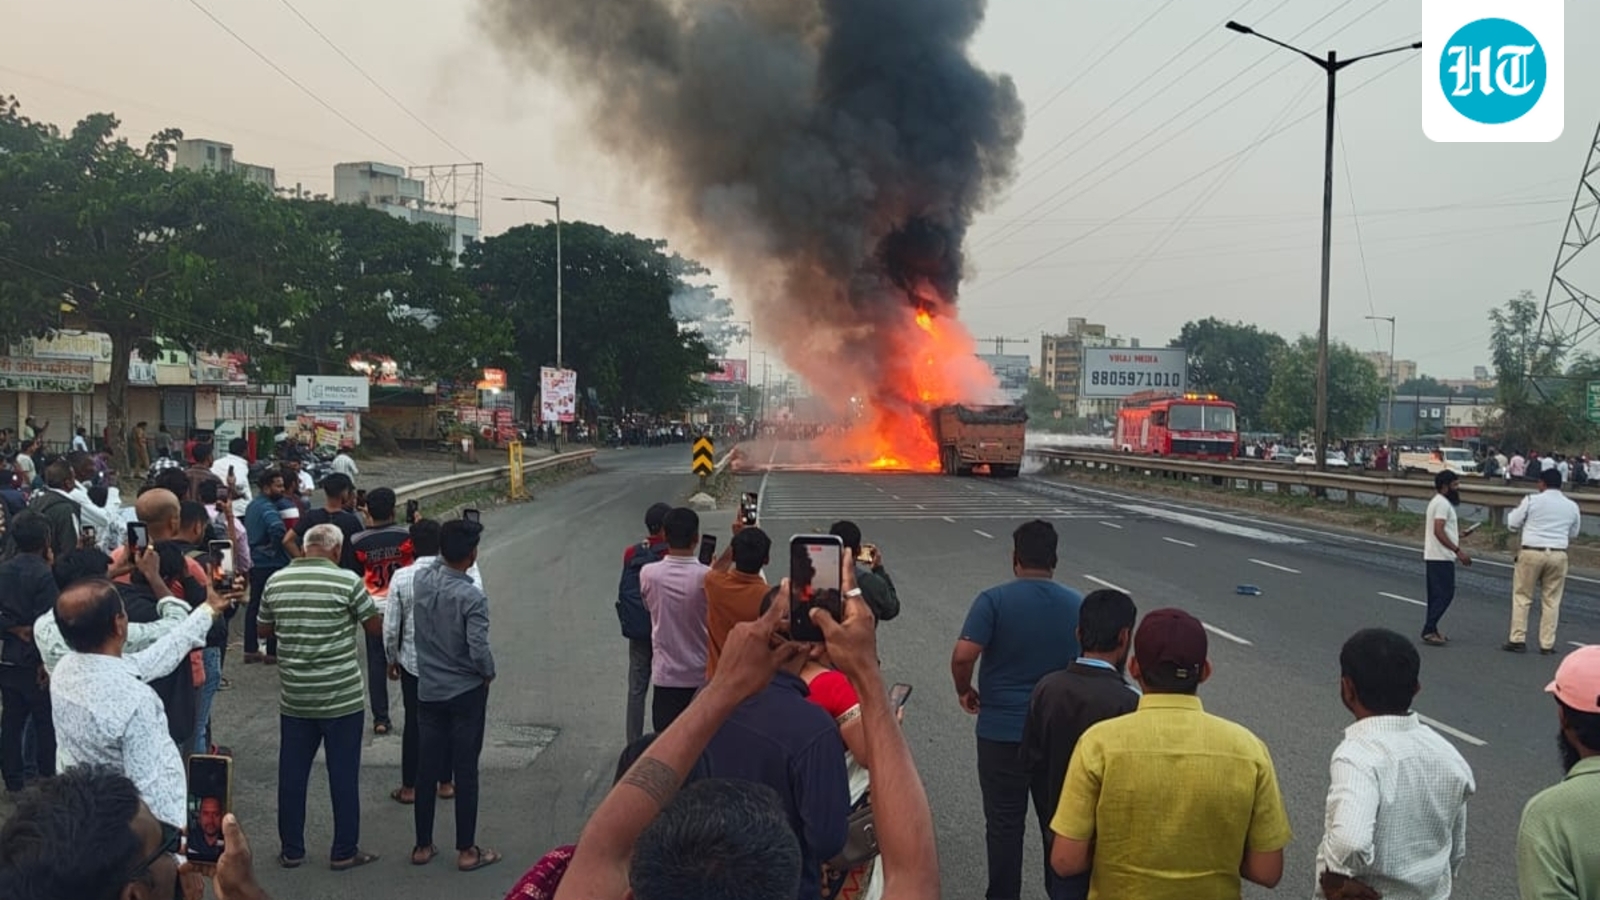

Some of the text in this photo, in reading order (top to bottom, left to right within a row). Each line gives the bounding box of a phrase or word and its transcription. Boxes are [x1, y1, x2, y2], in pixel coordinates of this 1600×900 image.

[1109, 354, 1158, 363] VIRAJ MEDIA
[1092, 371, 1180, 387] 8805971010
